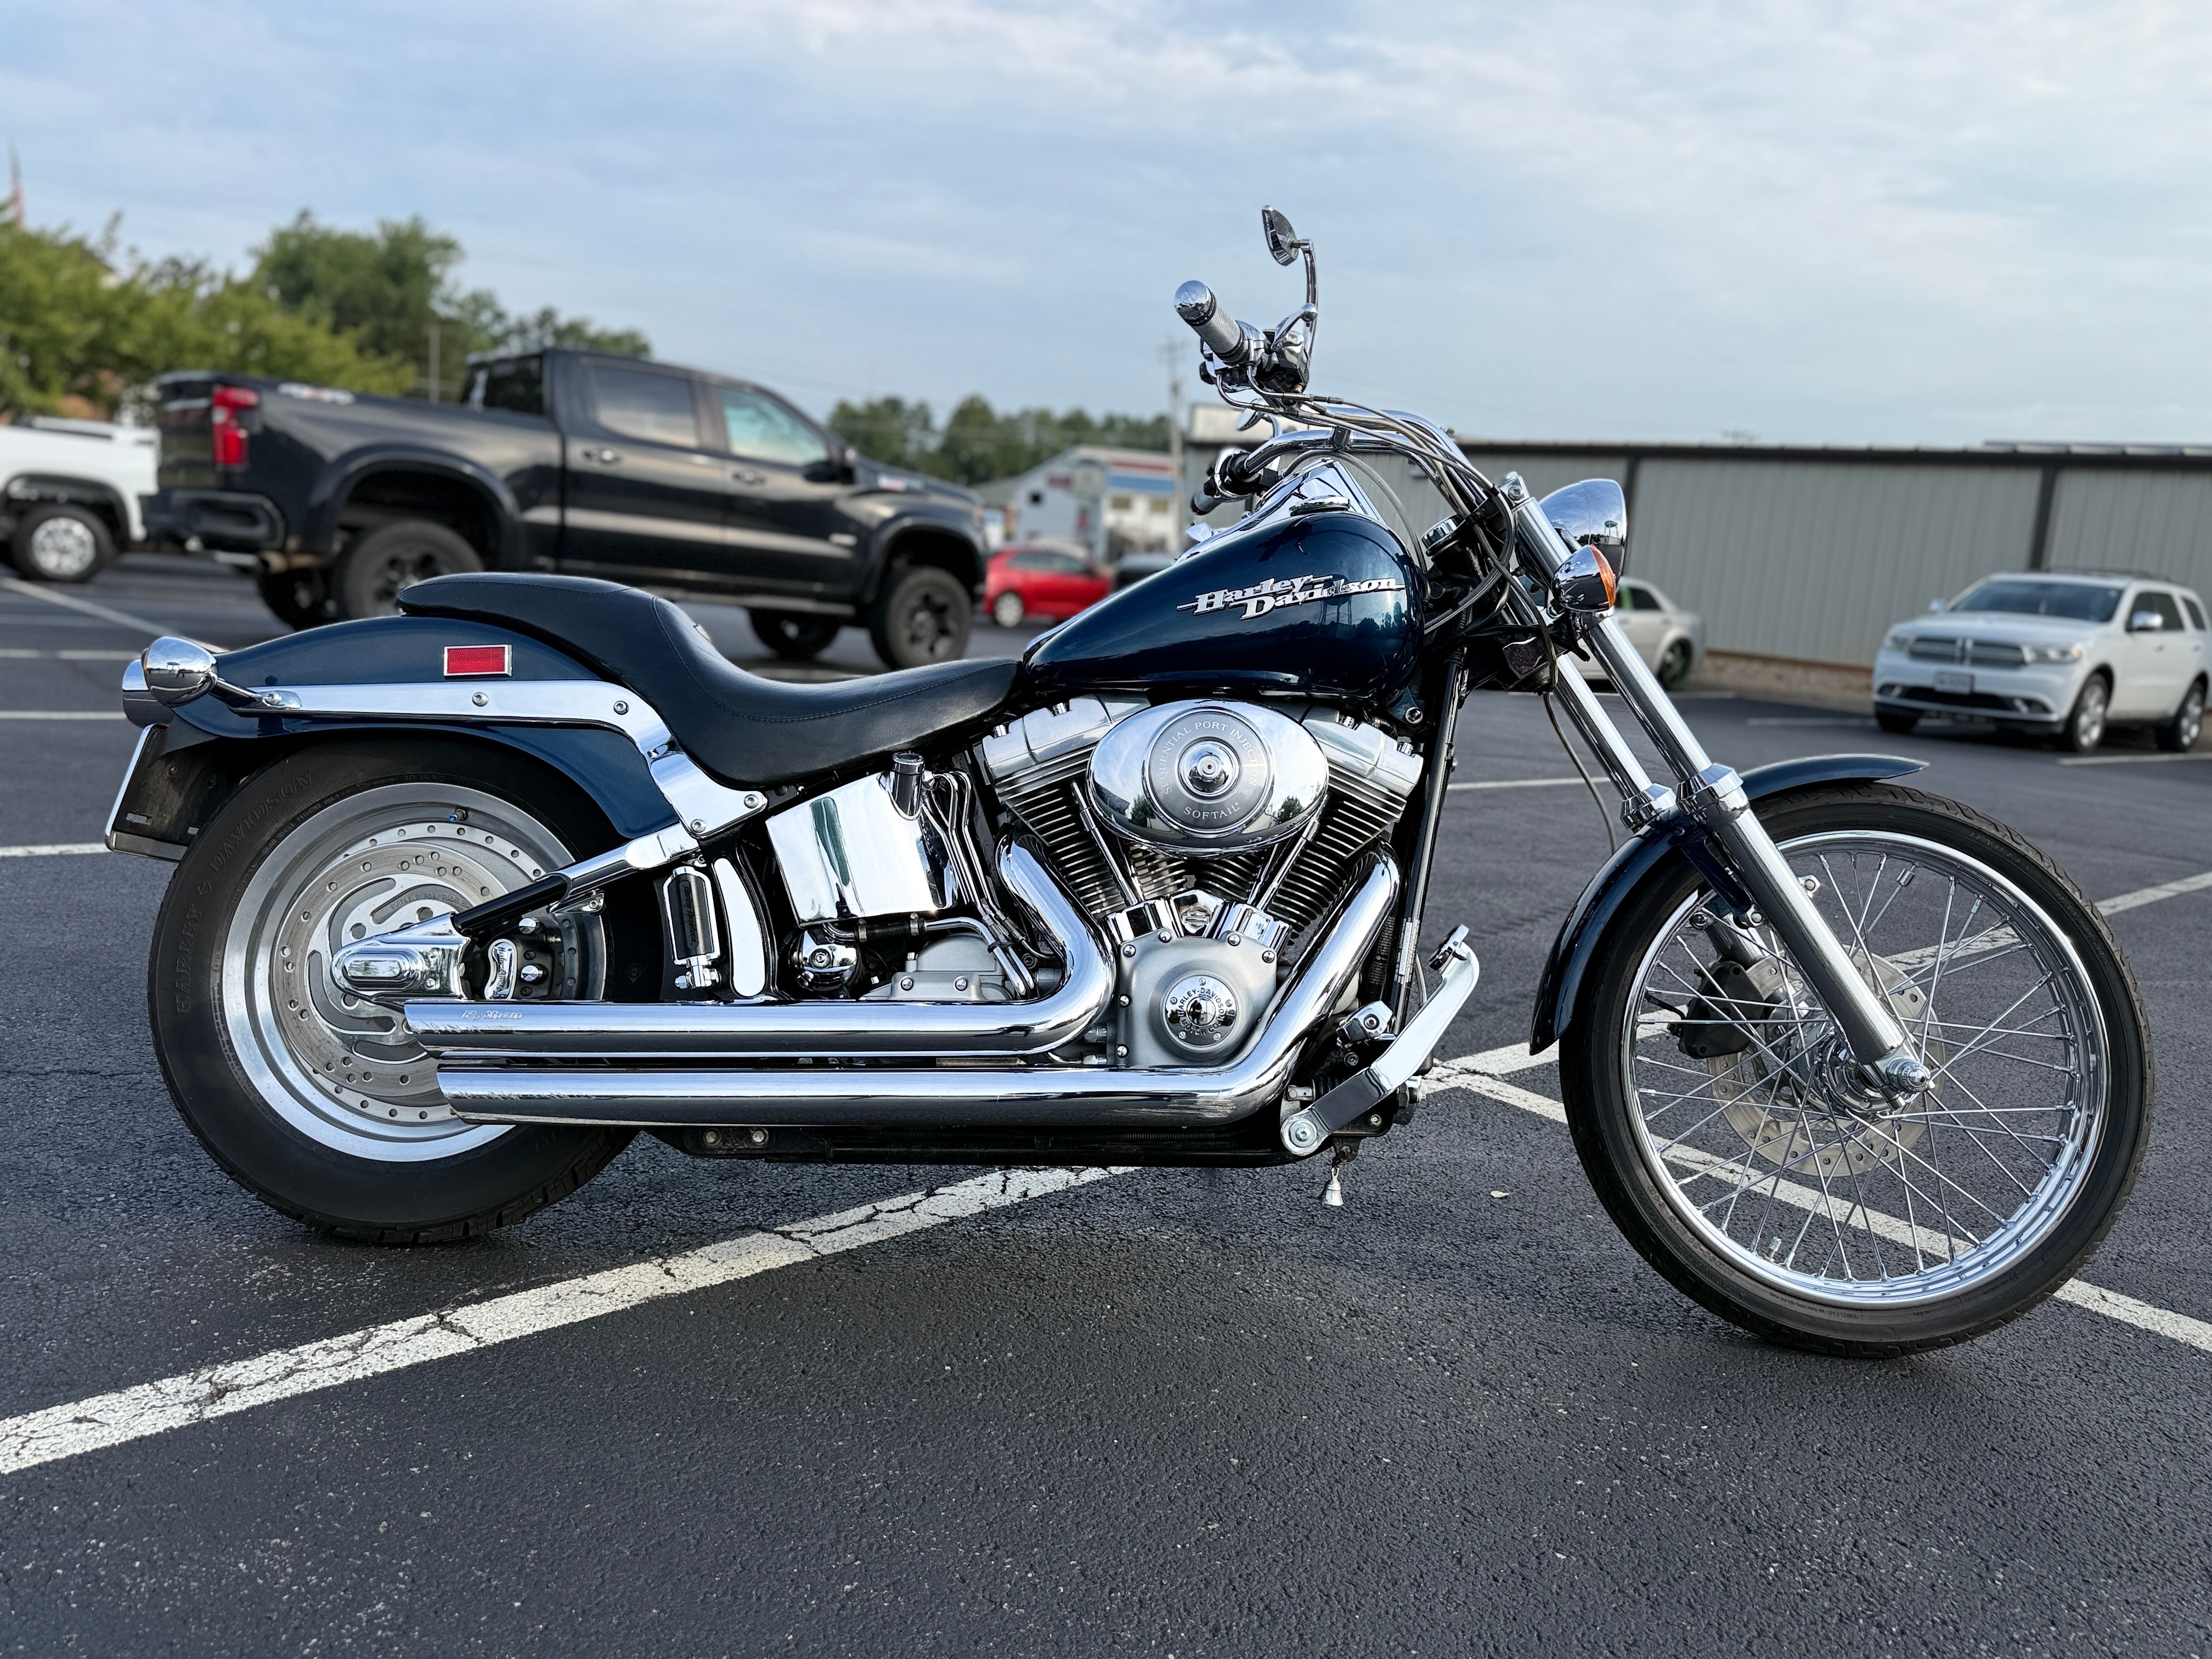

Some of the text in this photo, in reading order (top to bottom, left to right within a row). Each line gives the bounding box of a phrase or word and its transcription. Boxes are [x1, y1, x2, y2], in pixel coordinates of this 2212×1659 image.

[1188, 574, 1317, 616] Harley
[1229, 577, 1405, 621] Davidson
[1158, 720, 1260, 795] SEQUENTIAL PORT INJECTION
[1183, 805, 1240, 820] SOFTAIL
[175, 770, 312, 1015] HARLEY DAVIDSON
[461, 1009, 523, 1022] Python
[1177, 987, 1225, 1022] HARLEY-DAVIDSON
